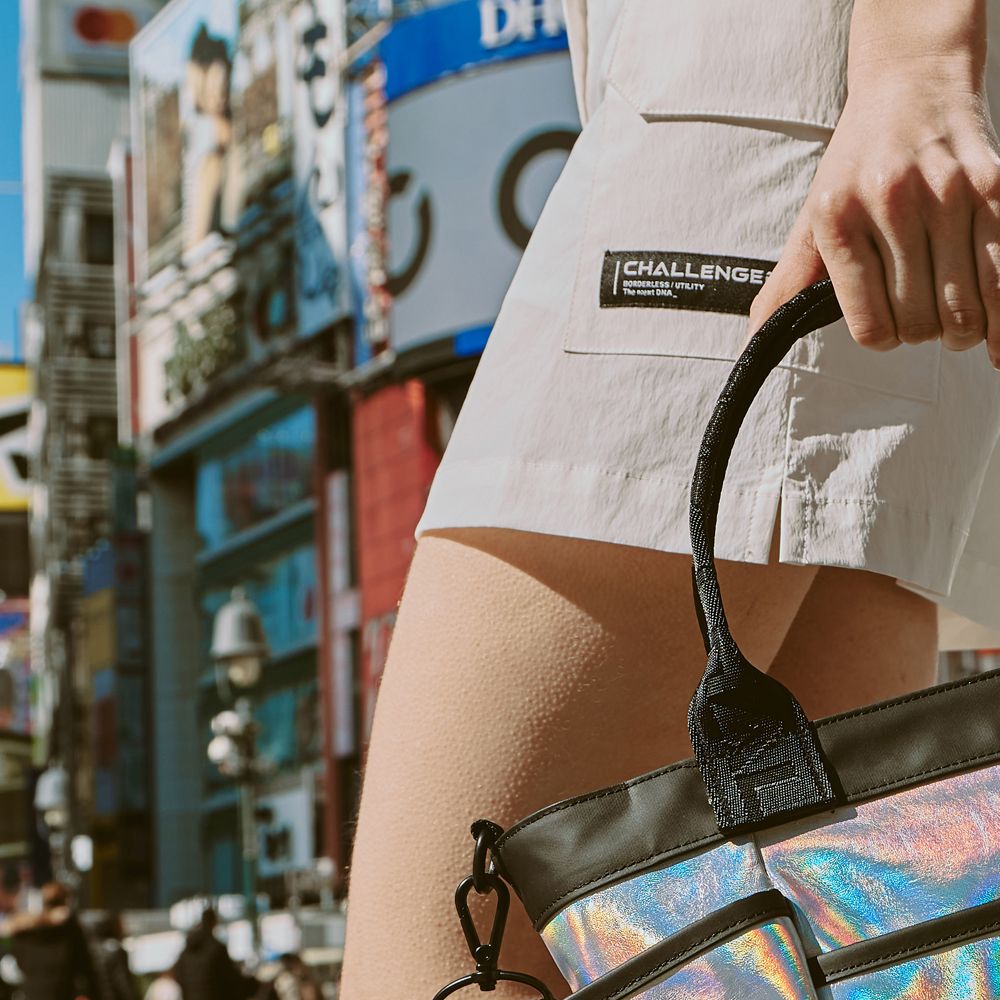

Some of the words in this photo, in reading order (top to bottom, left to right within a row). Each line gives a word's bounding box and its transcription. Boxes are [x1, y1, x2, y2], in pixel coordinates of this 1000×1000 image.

[481, 0, 567, 49] DH
[623, 280, 670, 289] BORDERLESS
[675, 282, 705, 291] UTILITY
[623, 288, 636, 296] The
